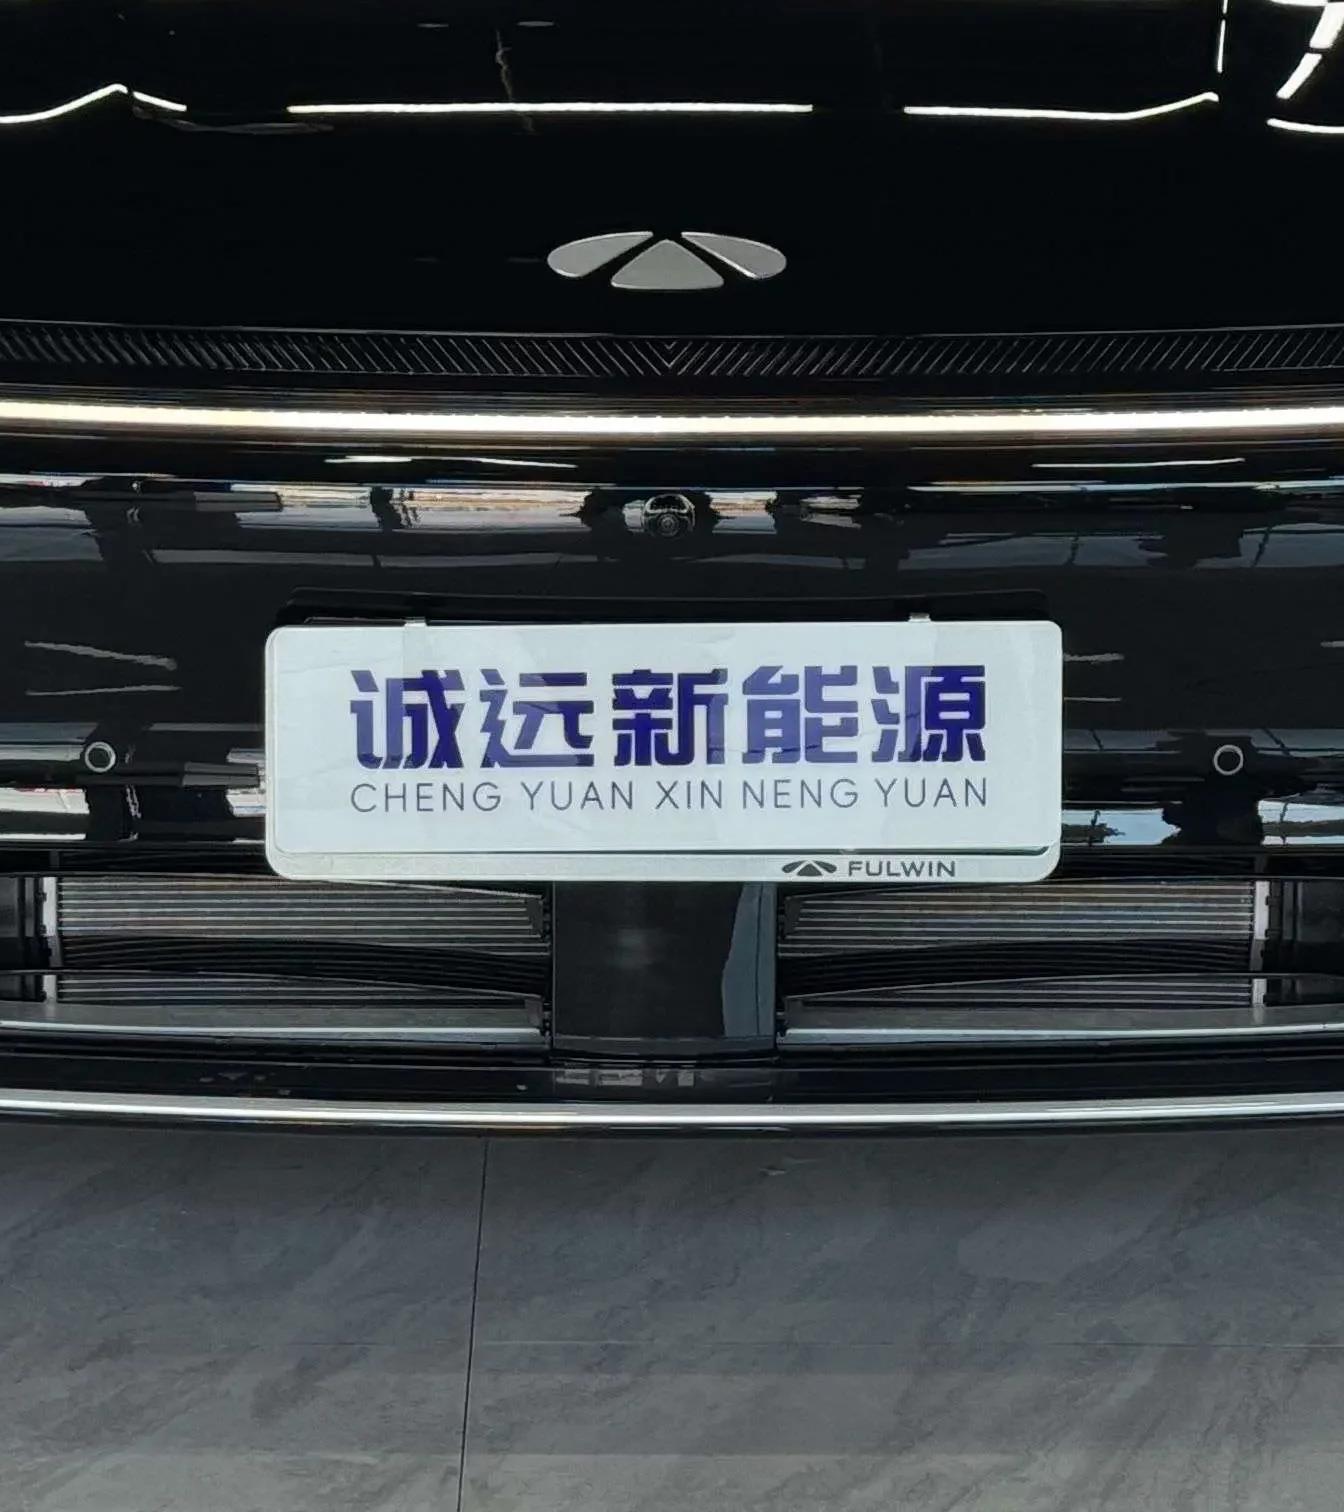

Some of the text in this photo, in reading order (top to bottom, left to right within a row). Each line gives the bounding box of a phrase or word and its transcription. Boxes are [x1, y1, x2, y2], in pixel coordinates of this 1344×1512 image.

[349, 664, 987, 769] 诚远新能源
[350, 777, 988, 813] CHENG YUAN XIN NENG YUAN
[848, 860, 956, 878] FULWIN
